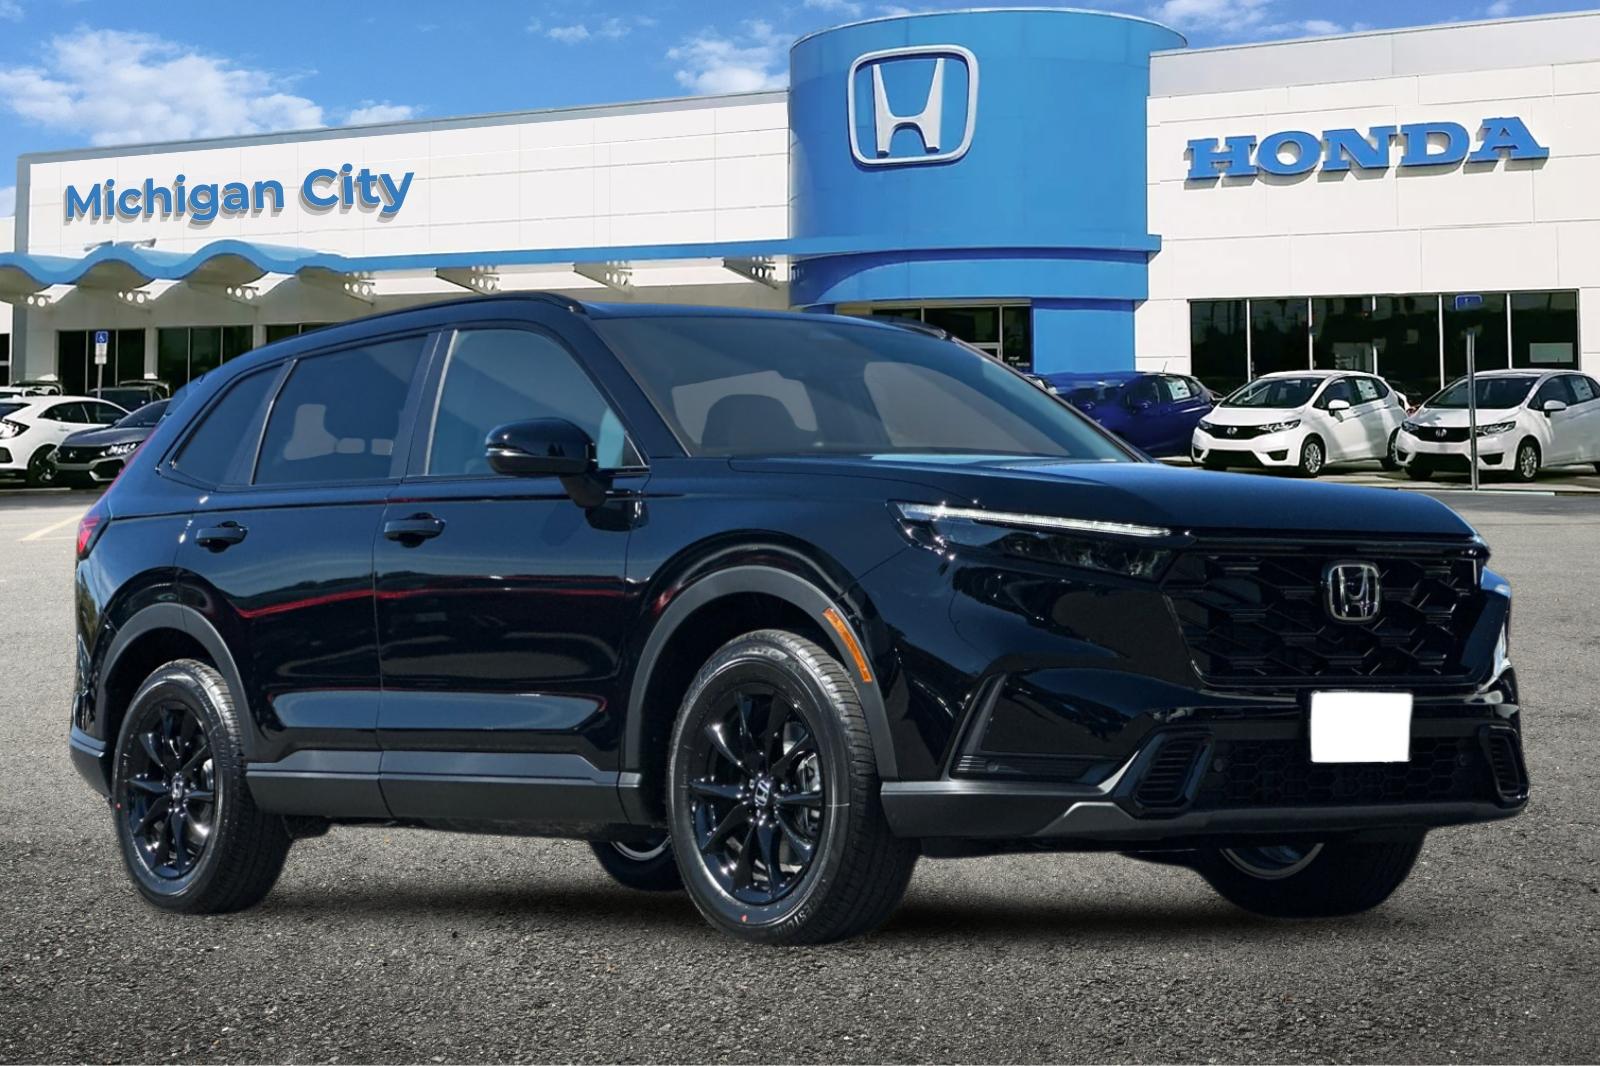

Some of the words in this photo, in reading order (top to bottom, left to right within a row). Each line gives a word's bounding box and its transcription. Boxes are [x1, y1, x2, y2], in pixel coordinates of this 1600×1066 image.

[1187, 116, 1549, 181] HONDA
[66, 174, 285, 222] Michigan
[303, 163, 415, 214] City
